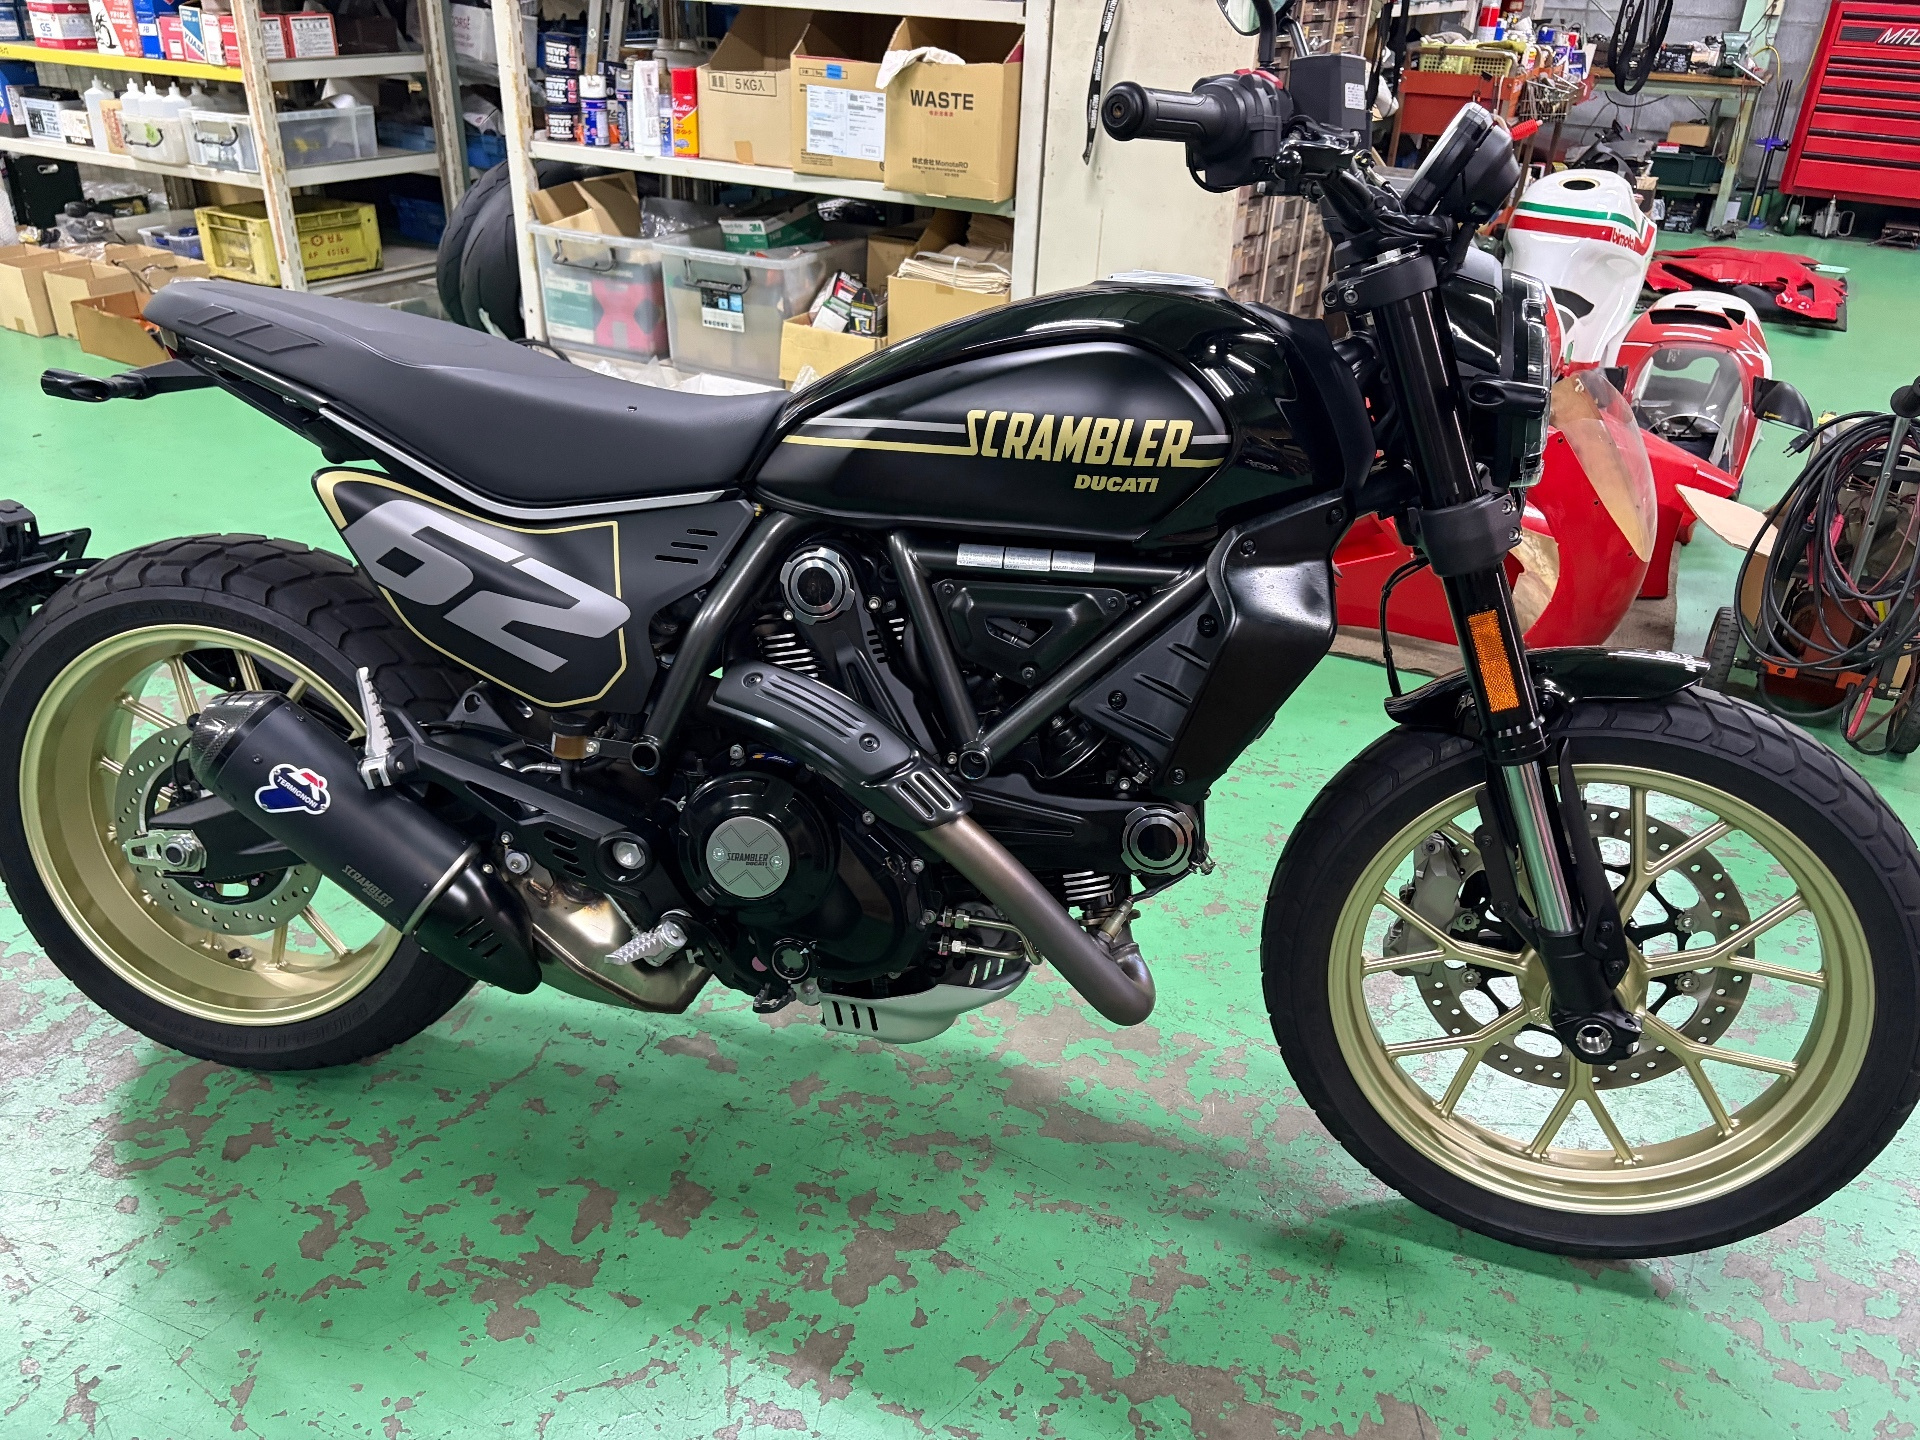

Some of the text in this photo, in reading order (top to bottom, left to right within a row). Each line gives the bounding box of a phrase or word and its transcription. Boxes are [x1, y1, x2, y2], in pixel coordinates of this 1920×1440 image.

[910, 89, 974, 111] WASTE
[749, 223, 762, 232] 3M
[966, 409, 1194, 468] SCRAMBLER
[1074, 474, 1159, 493] DUCATI
[277, 776, 319, 809] TERMIGNONI
[727, 852, 769, 862] SCRAMBLER
[341, 864, 394, 905] SCRAMBLER
